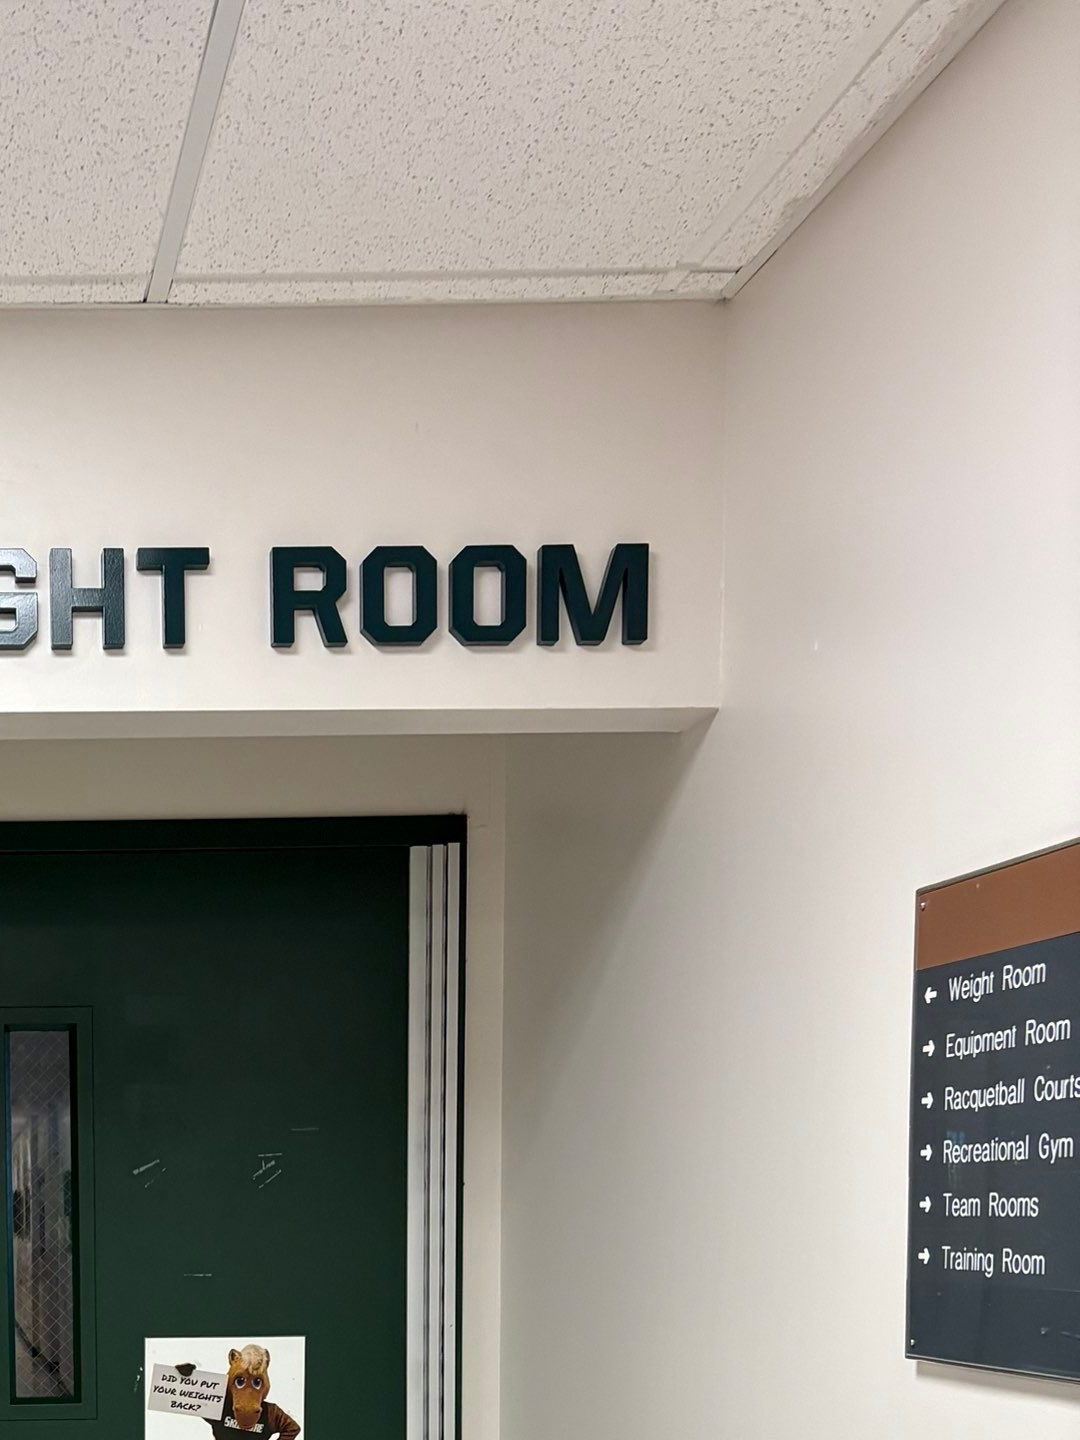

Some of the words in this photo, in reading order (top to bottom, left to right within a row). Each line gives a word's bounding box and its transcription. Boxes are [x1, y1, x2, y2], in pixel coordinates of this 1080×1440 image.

[269, 543, 650, 649] ROOM
[948, 970, 995, 1002] Weight
[1002, 962, 1047, 991] Room
[945, 1025, 1017, 1060] Equipment
[1024, 1018, 1071, 1046] Room
[944, 1077, 1025, 1112] Racquetball
[1033, 1074, 1080, 1102] Courts
[943, 1134, 1030, 1164] Recreational
[1038, 1132, 1074, 1164] Gym
[942, 1192, 981, 1217] Team
[988, 1191, 1039, 1218] Rooms
[941, 1245, 994, 1278] Training
[1001, 1247, 1046, 1275] Room
[152, 1385, 177, 1396] YOUR
[179, 1389, 223, 1403] WEIGHTS
[161, 1374, 177, 1382] DID
[179, 1377, 198, 1386] YOU
[200, 1380, 219, 1389] PUT
[170, 1400, 201, 1411] BACK?
